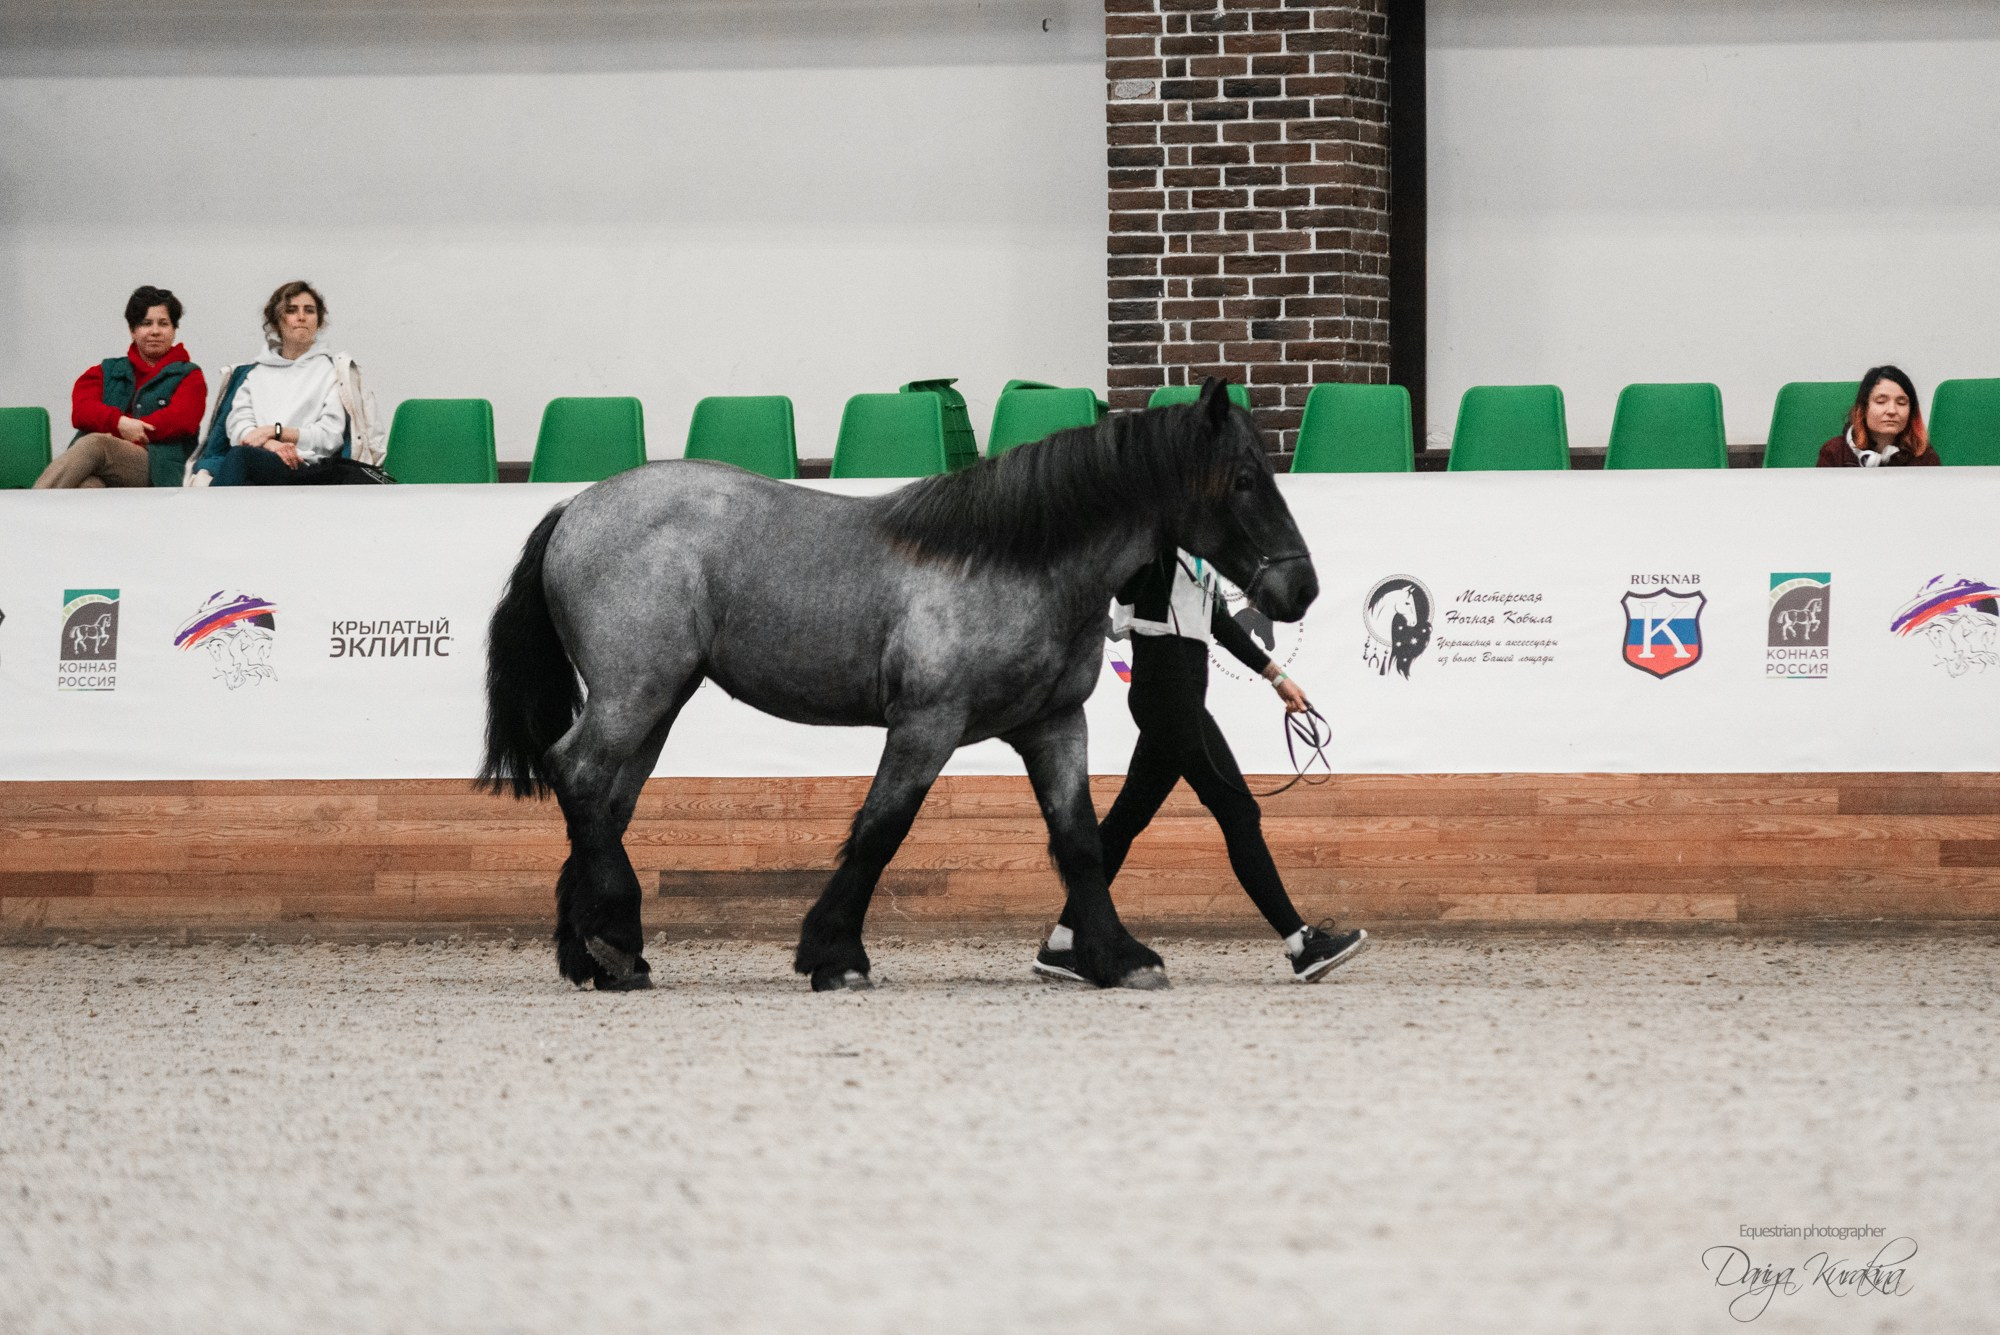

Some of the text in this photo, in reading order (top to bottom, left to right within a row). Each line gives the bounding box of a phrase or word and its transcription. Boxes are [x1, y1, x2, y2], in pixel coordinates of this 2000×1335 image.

[1631, 574, 1701, 585] RUSKNAB
[1455, 589, 1543, 606] Мастерская
[332, 616, 450, 635] КРЫЛАТЫЙ
[1445, 610, 1553, 626] Ночная Кобыла
[1638, 602, 1691, 658] K
[329, 636, 451, 658] ЭКЛИПС
[1437, 636, 1491, 650] Украшения
[1505, 638, 1559, 649] аксессуары
[1437, 656, 1449, 667] из
[1452, 652, 1477, 663] волос
[1482, 651, 1515, 663] Вашей
[1767, 648, 1829, 660] КОННАЯ
[59, 662, 117, 673] КОННАЯ
[1766, 663, 1828, 675] РОССИЯ
[58, 676, 116, 687] РОССИЯ
